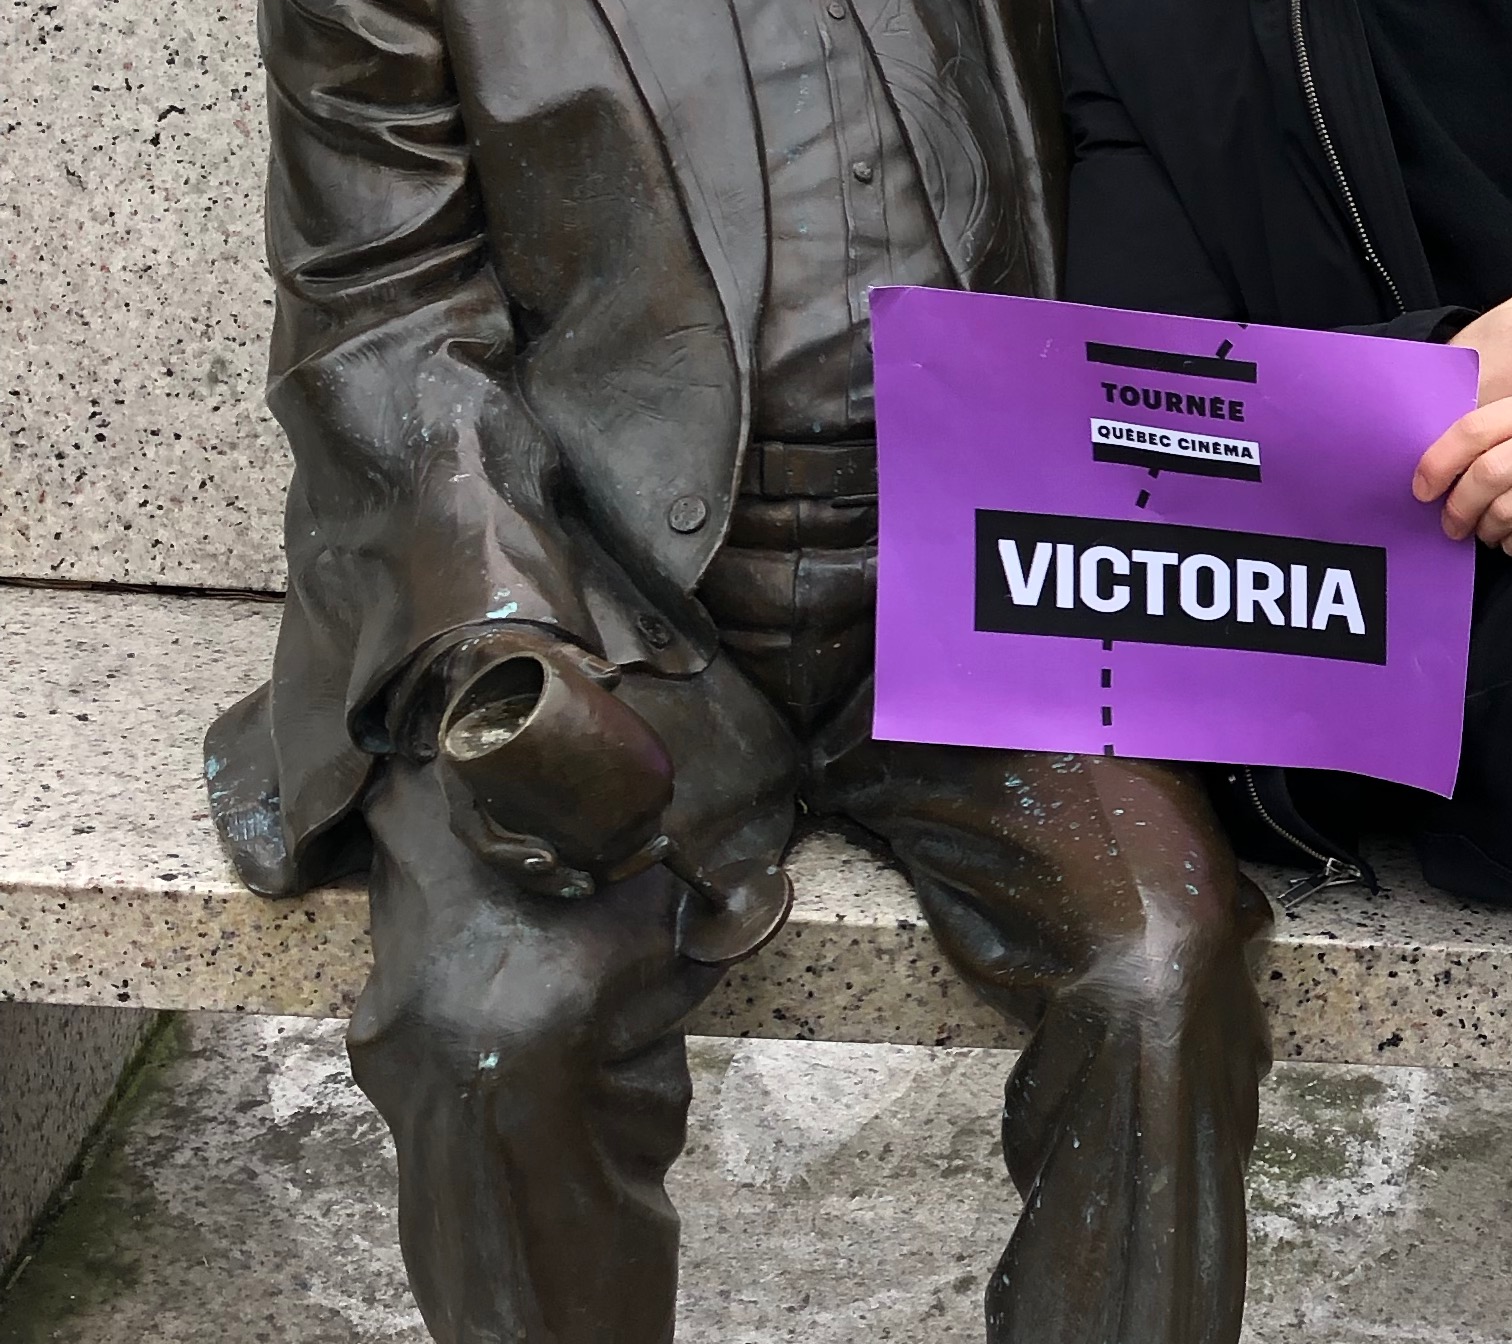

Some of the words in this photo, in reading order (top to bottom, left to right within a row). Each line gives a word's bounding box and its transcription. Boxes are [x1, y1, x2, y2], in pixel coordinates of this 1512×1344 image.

[1101, 382, 1245, 422] TOURNÉE
[1097, 425, 1172, 447] QUÉBEC
[1178, 437, 1255, 460] CINÉMA
[998, 539, 1367, 635] VICTORIA
